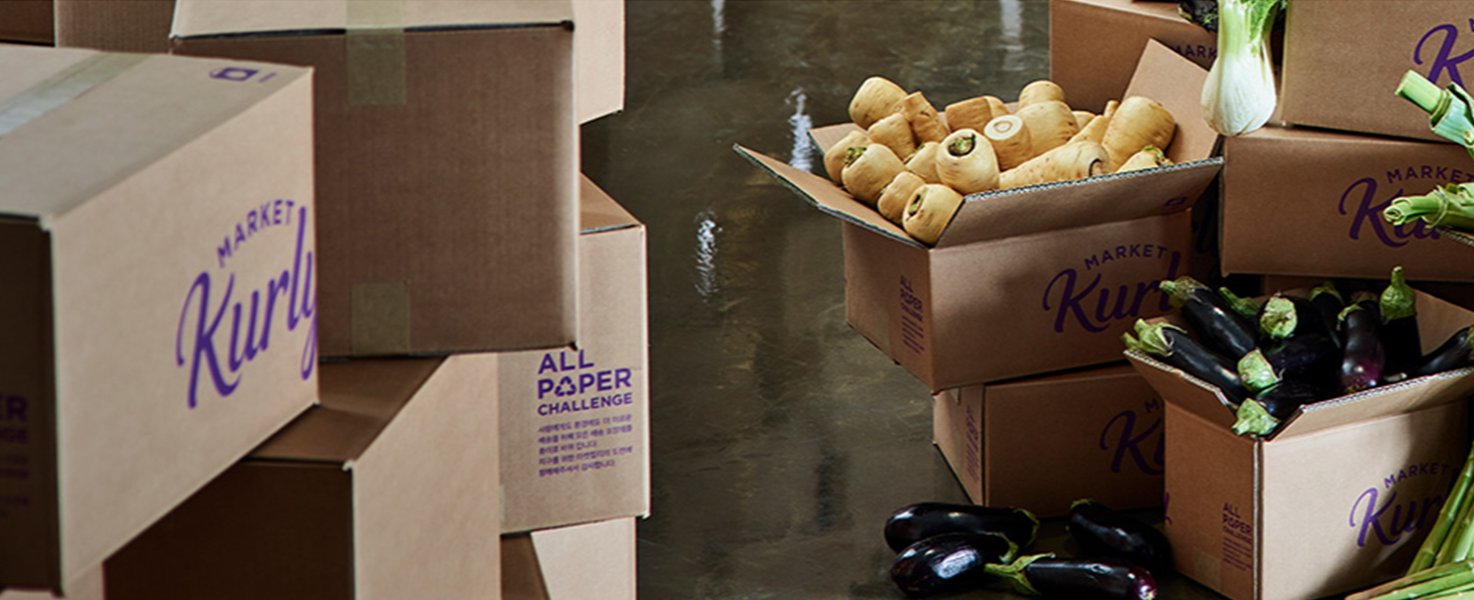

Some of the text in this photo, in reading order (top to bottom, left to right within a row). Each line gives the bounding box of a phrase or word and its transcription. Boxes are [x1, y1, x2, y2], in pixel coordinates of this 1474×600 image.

[217, 199, 296, 269] MARKET
[1084, 244, 1168, 271] MARKET
[1043, 251, 1181, 333] Kurl
[176, 206, 318, 410] Kurly
[538, 349, 595, 375] ALL
[537, 392, 634, 416] CHALLENGE
[1384, 462, 1449, 489] MARKET
